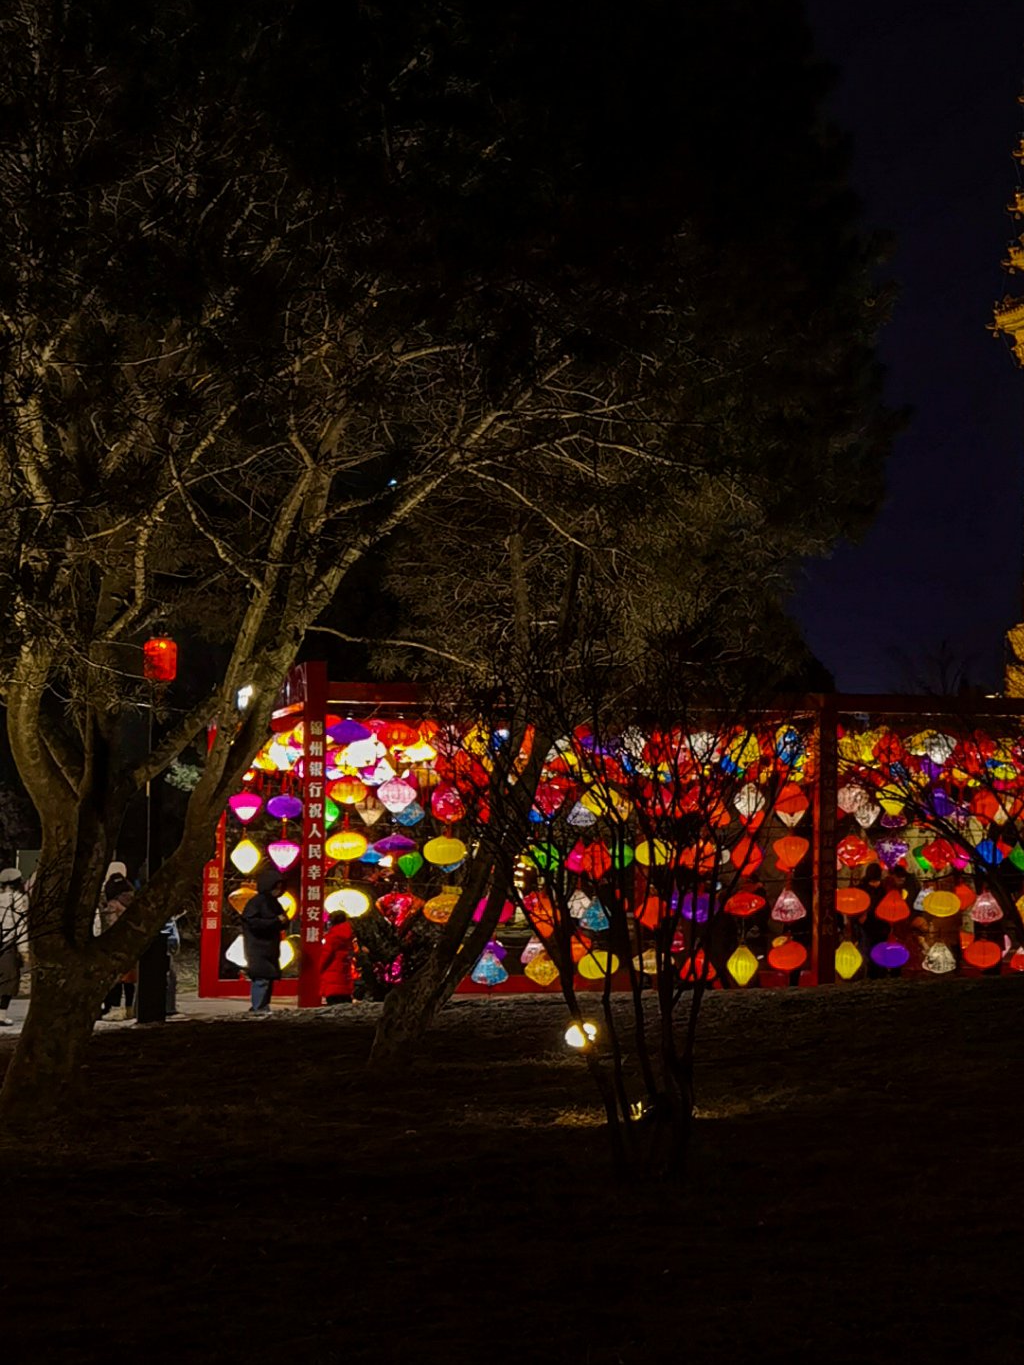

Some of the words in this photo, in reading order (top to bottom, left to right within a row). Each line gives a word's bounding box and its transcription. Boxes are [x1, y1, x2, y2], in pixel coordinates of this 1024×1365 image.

[306, 720, 323, 943] 锦州银行祝人民幸福安康
